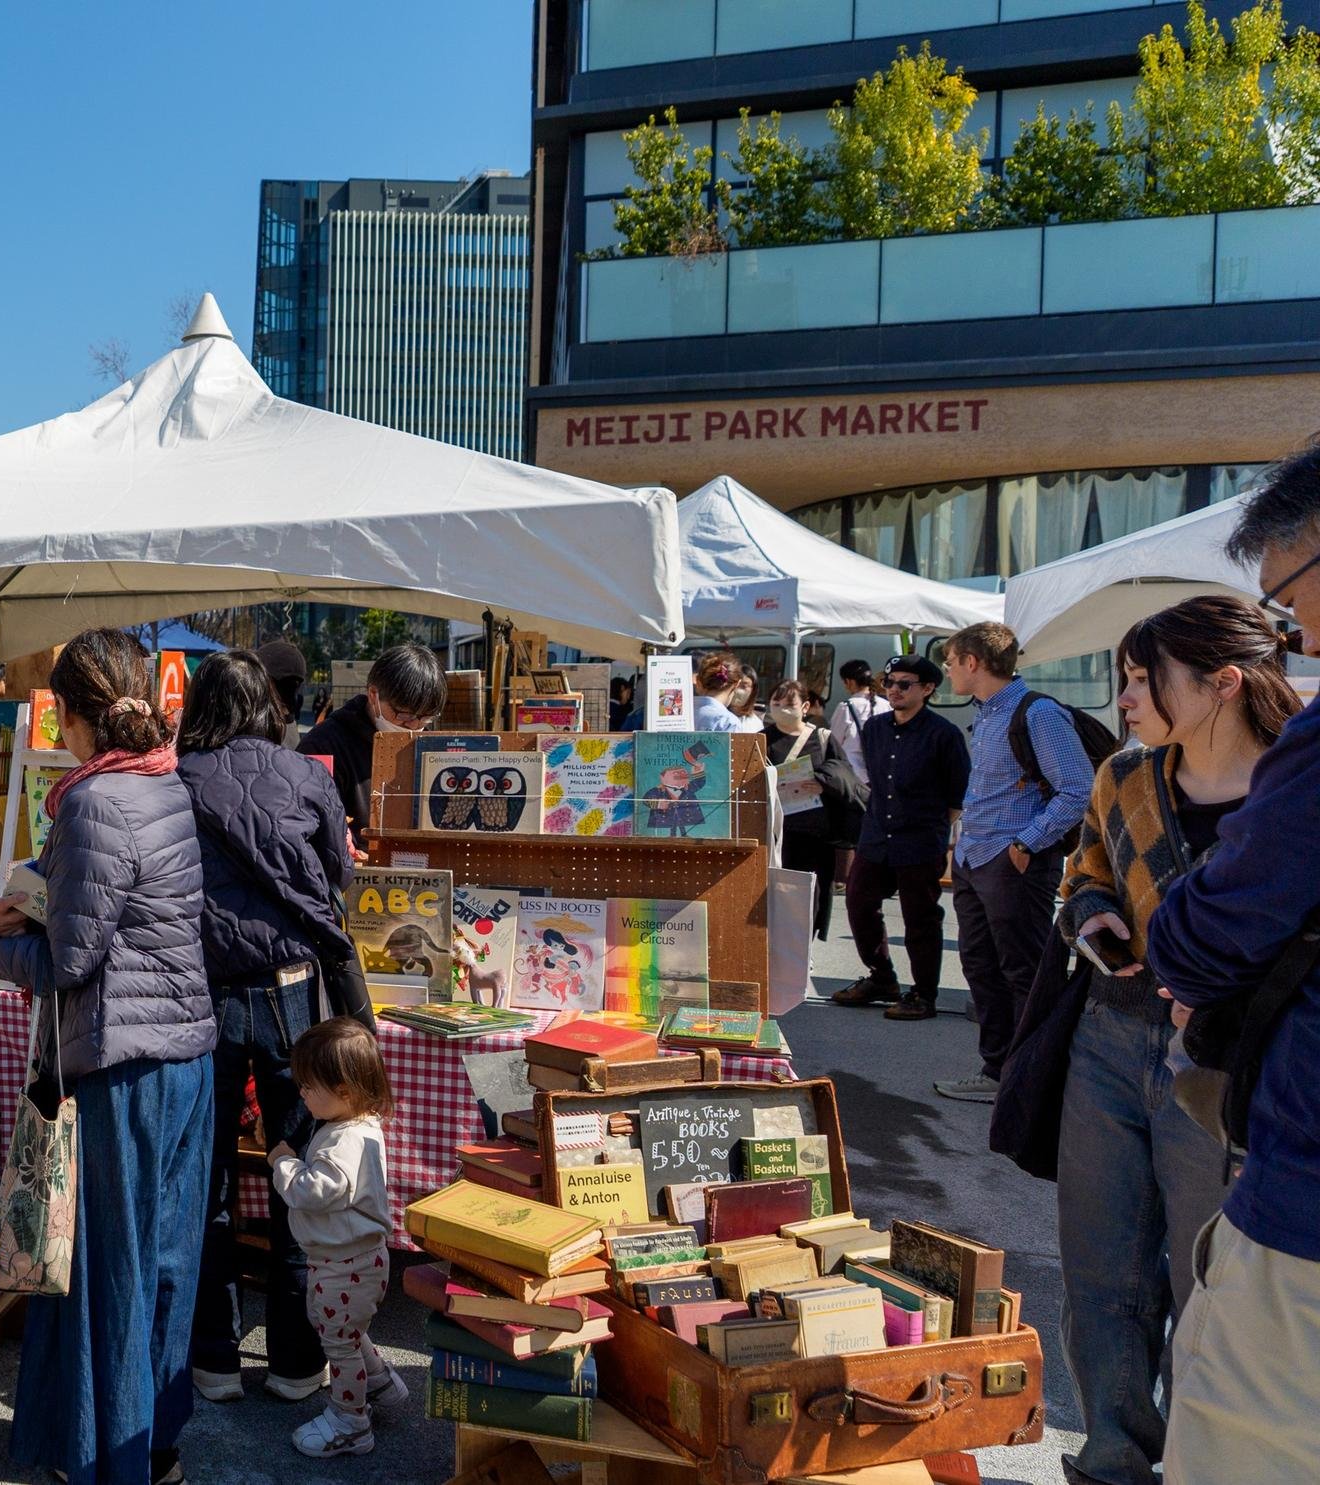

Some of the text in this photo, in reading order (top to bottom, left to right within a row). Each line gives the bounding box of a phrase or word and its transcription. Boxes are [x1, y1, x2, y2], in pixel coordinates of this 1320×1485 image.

[566, 400, 988, 447] MEIJI PARK MARKET
[498, 756, 521, 764] Happy
[36, 776, 54, 786] Fin
[354, 875, 379, 885] THE
[358, 887, 439, 917] ABC
[545, 901, 558, 911] IN
[560, 902, 601, 913] BOOTS
[621, 917, 694, 932] Wasteground
[640, 932, 675, 945] Circus
[646, 1106, 691, 1124] Antique
[701, 1105, 742, 1122] Vintage
[679, 1120, 729, 1139] BOOKS
[754, 1142, 791, 1153] Baskets
[651, 1139, 701, 1171] 550
[769, 1154, 784, 1163] and
[754, 1163, 797, 1176] Basketry
[567, 1172, 632, 1187] Annaluise
[569, 1192, 620, 1206] & Anton
[659, 1287, 712, 1300] FAUST
